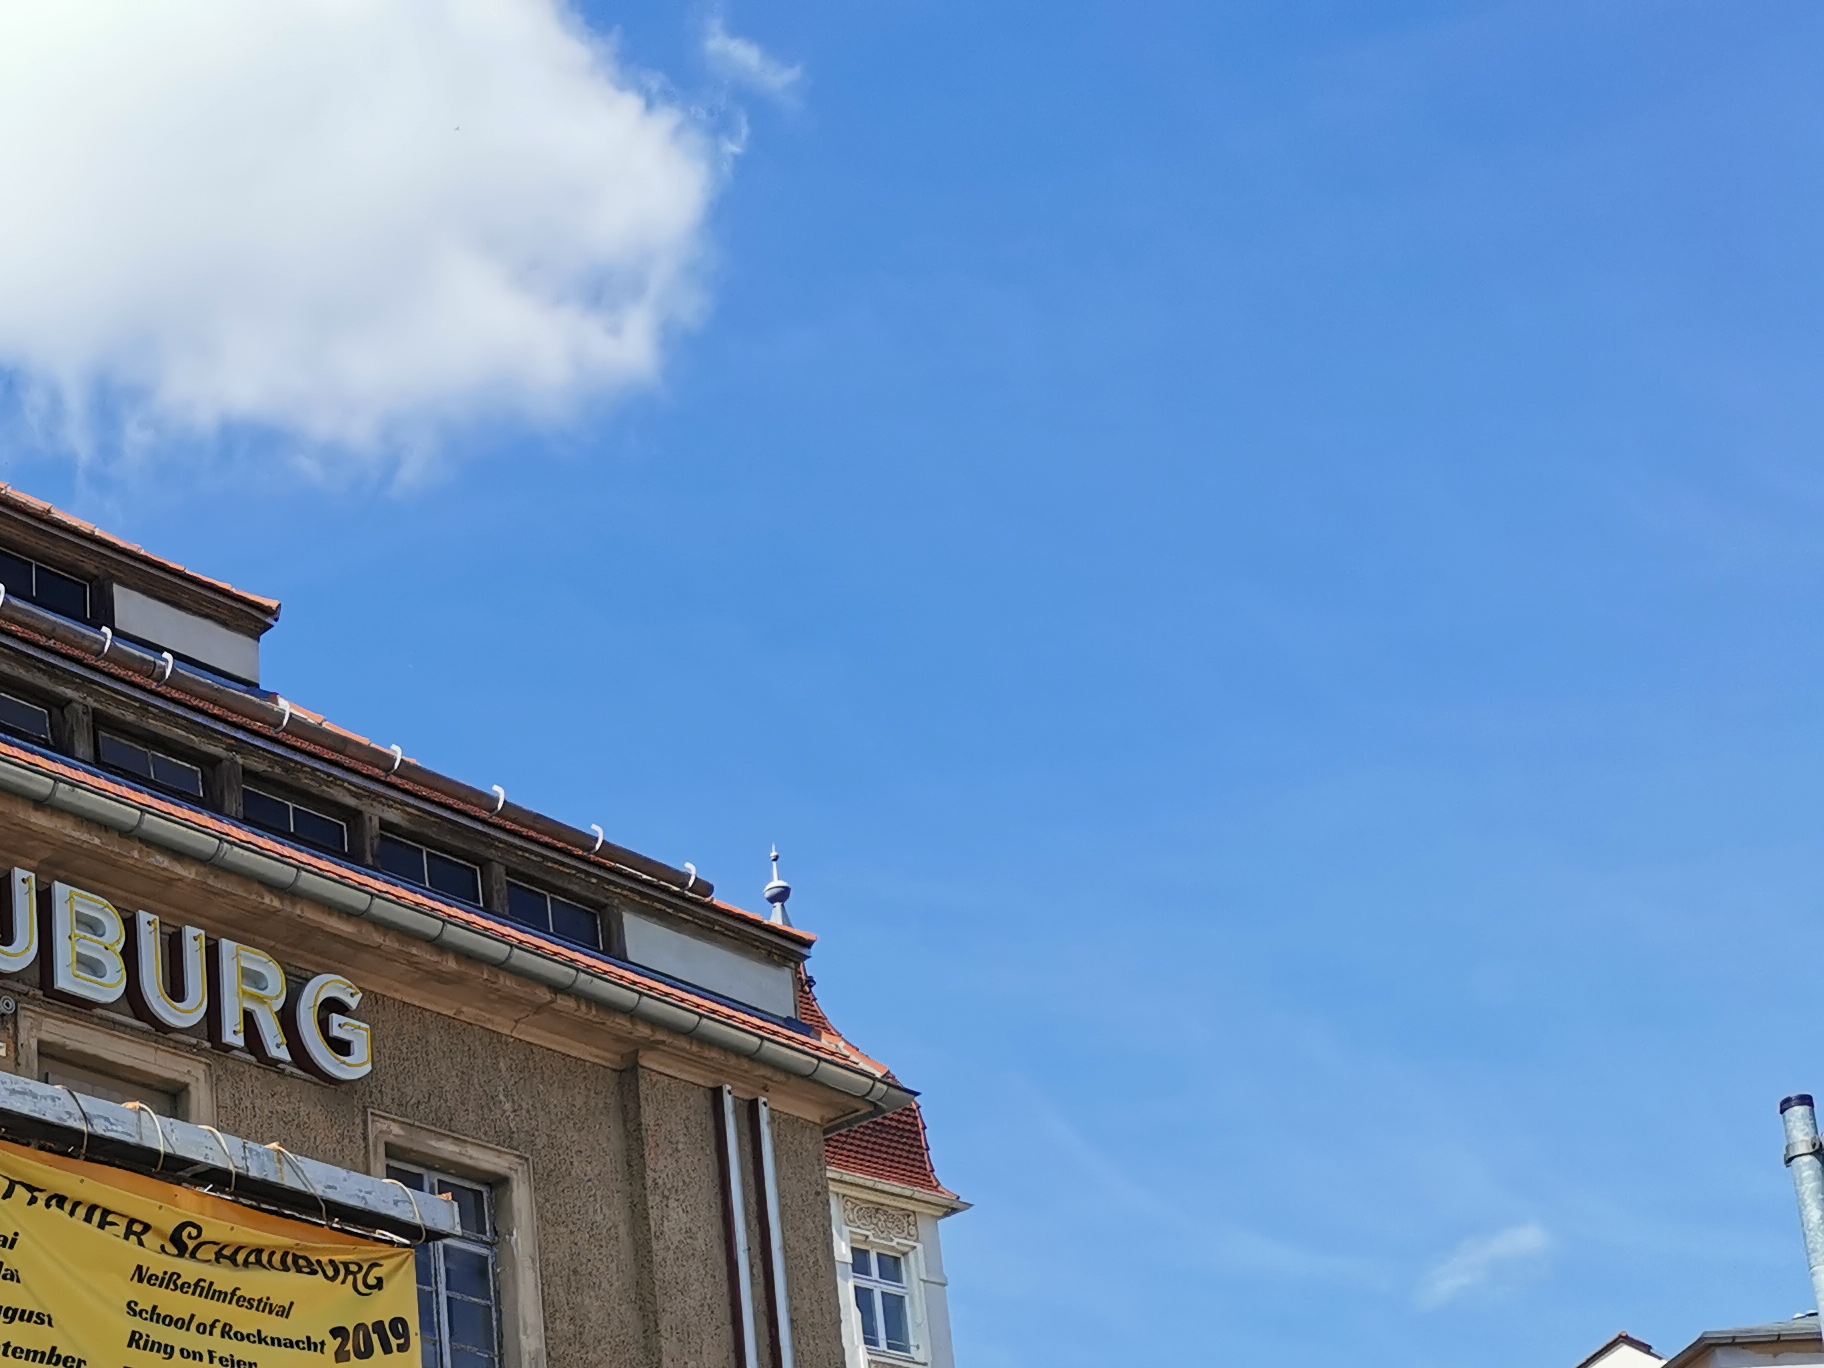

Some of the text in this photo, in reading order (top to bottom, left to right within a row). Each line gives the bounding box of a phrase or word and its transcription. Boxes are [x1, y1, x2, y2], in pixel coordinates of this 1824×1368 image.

[161, 1220, 384, 1297] SCHAUBURG
[129, 1263, 295, 1320] Neißefilmfestival
[125, 1299, 327, 1355] School of Rocknacht
[126, 1329, 175, 1361] Ring
[179, 1345, 204, 1363] on
[328, 1316, 411, 1364] 2019
